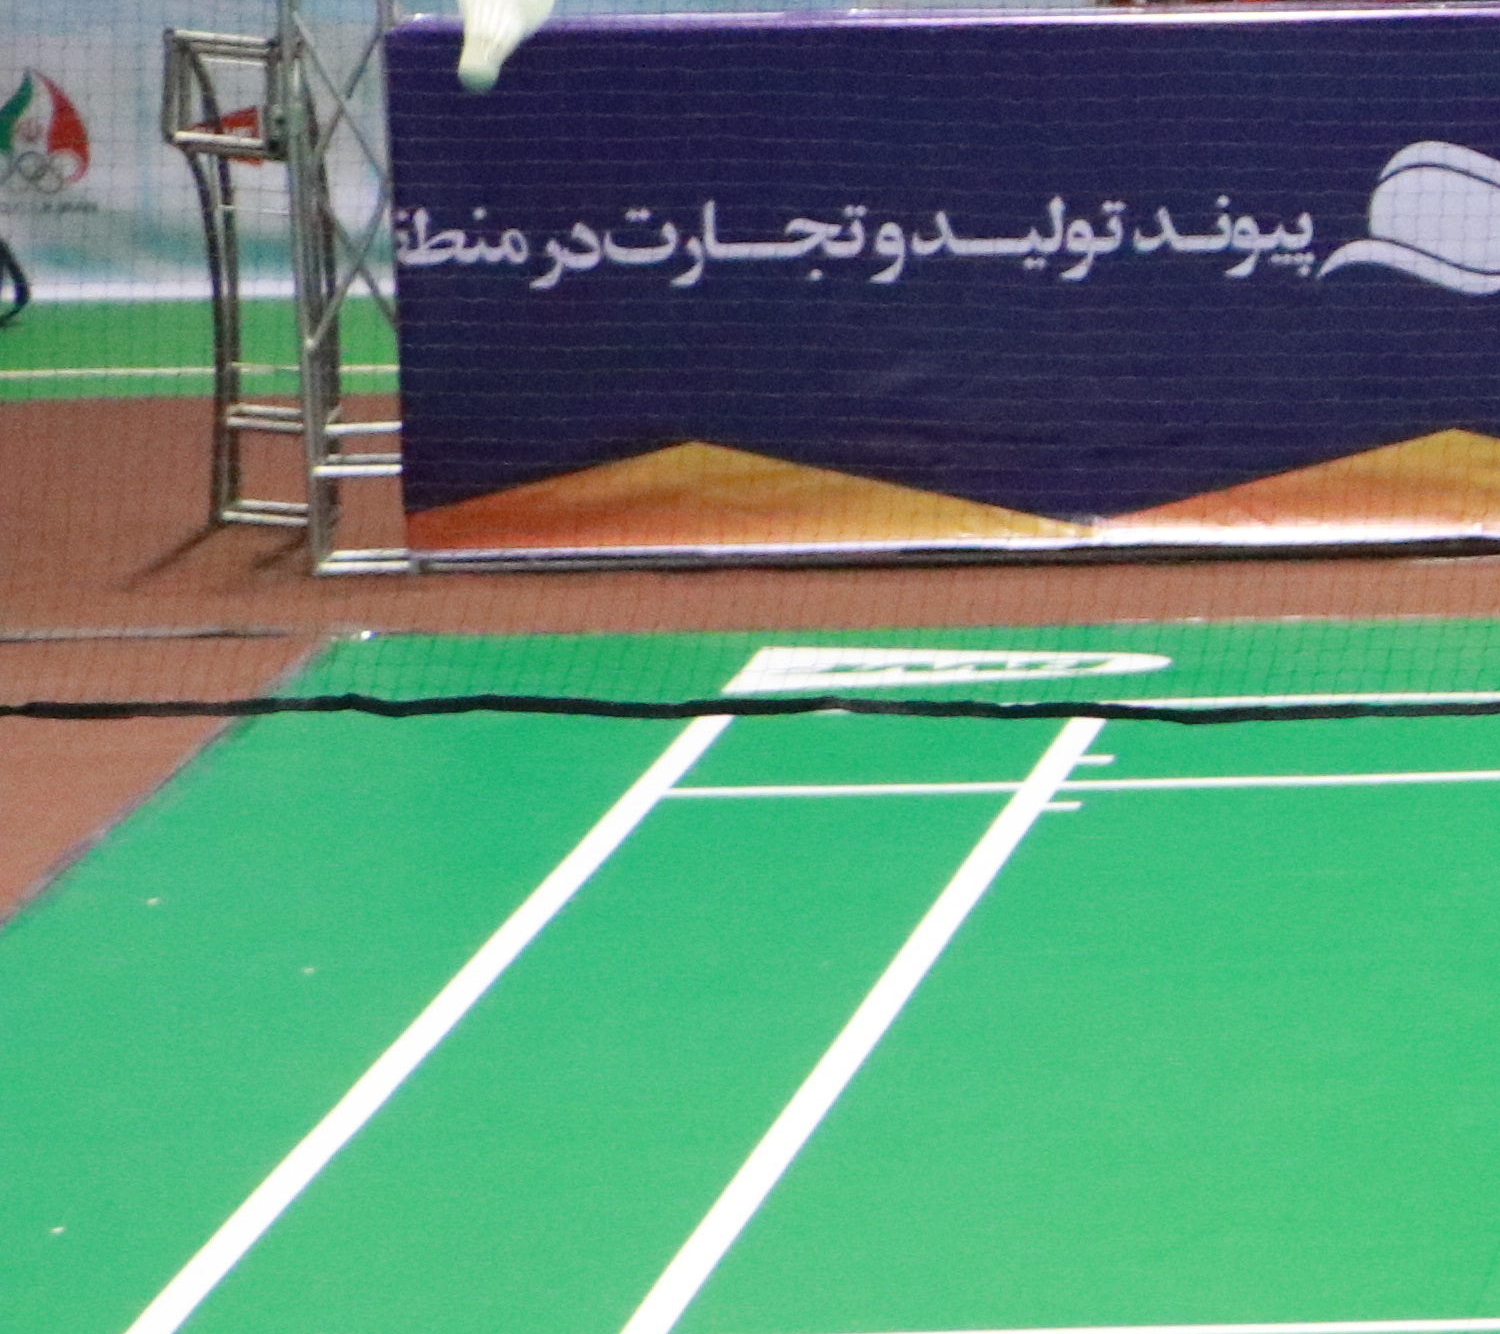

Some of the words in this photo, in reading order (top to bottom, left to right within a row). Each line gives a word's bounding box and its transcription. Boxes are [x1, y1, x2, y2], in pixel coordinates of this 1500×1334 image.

[529, 222, 602, 289] در
[604, 200, 868, 288] تجارت
[869, 221, 905, 284] و
[912, 196, 1127, 282] تولید
[1134, 195, 1315, 277] پیوند
